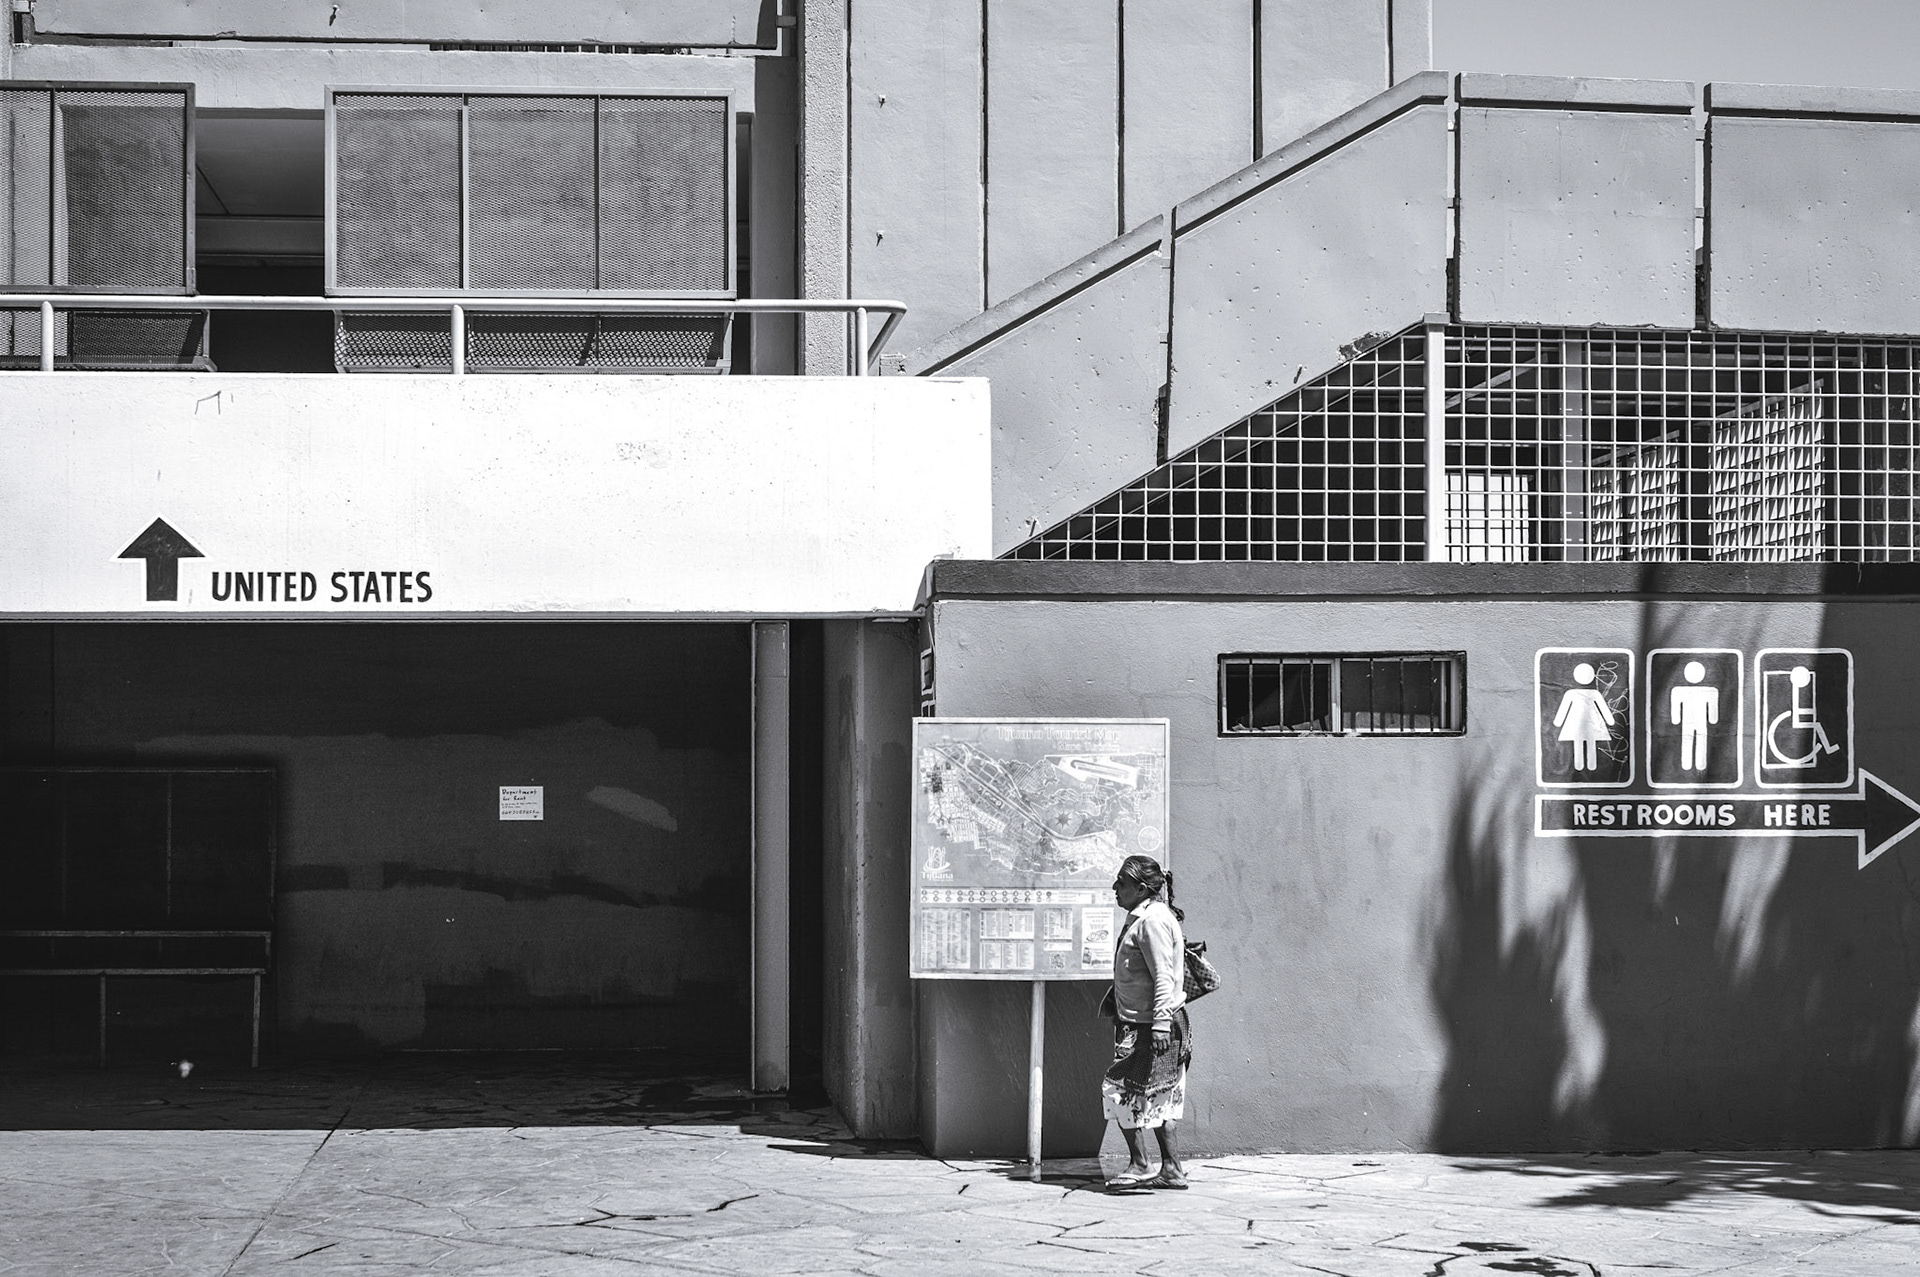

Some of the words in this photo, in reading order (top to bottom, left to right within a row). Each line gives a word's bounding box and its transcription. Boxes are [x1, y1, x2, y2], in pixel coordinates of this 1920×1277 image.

[212, 571, 317, 602] UNITED
[330, 571, 433, 603] STATES
[997, 726, 1043, 741] Tijuana
[1044, 727, 1091, 740] Tourist
[1095, 728, 1120, 742] Map
[1763, 803, 1831, 827] HERE
[921, 872, 954, 882] Tijuana
